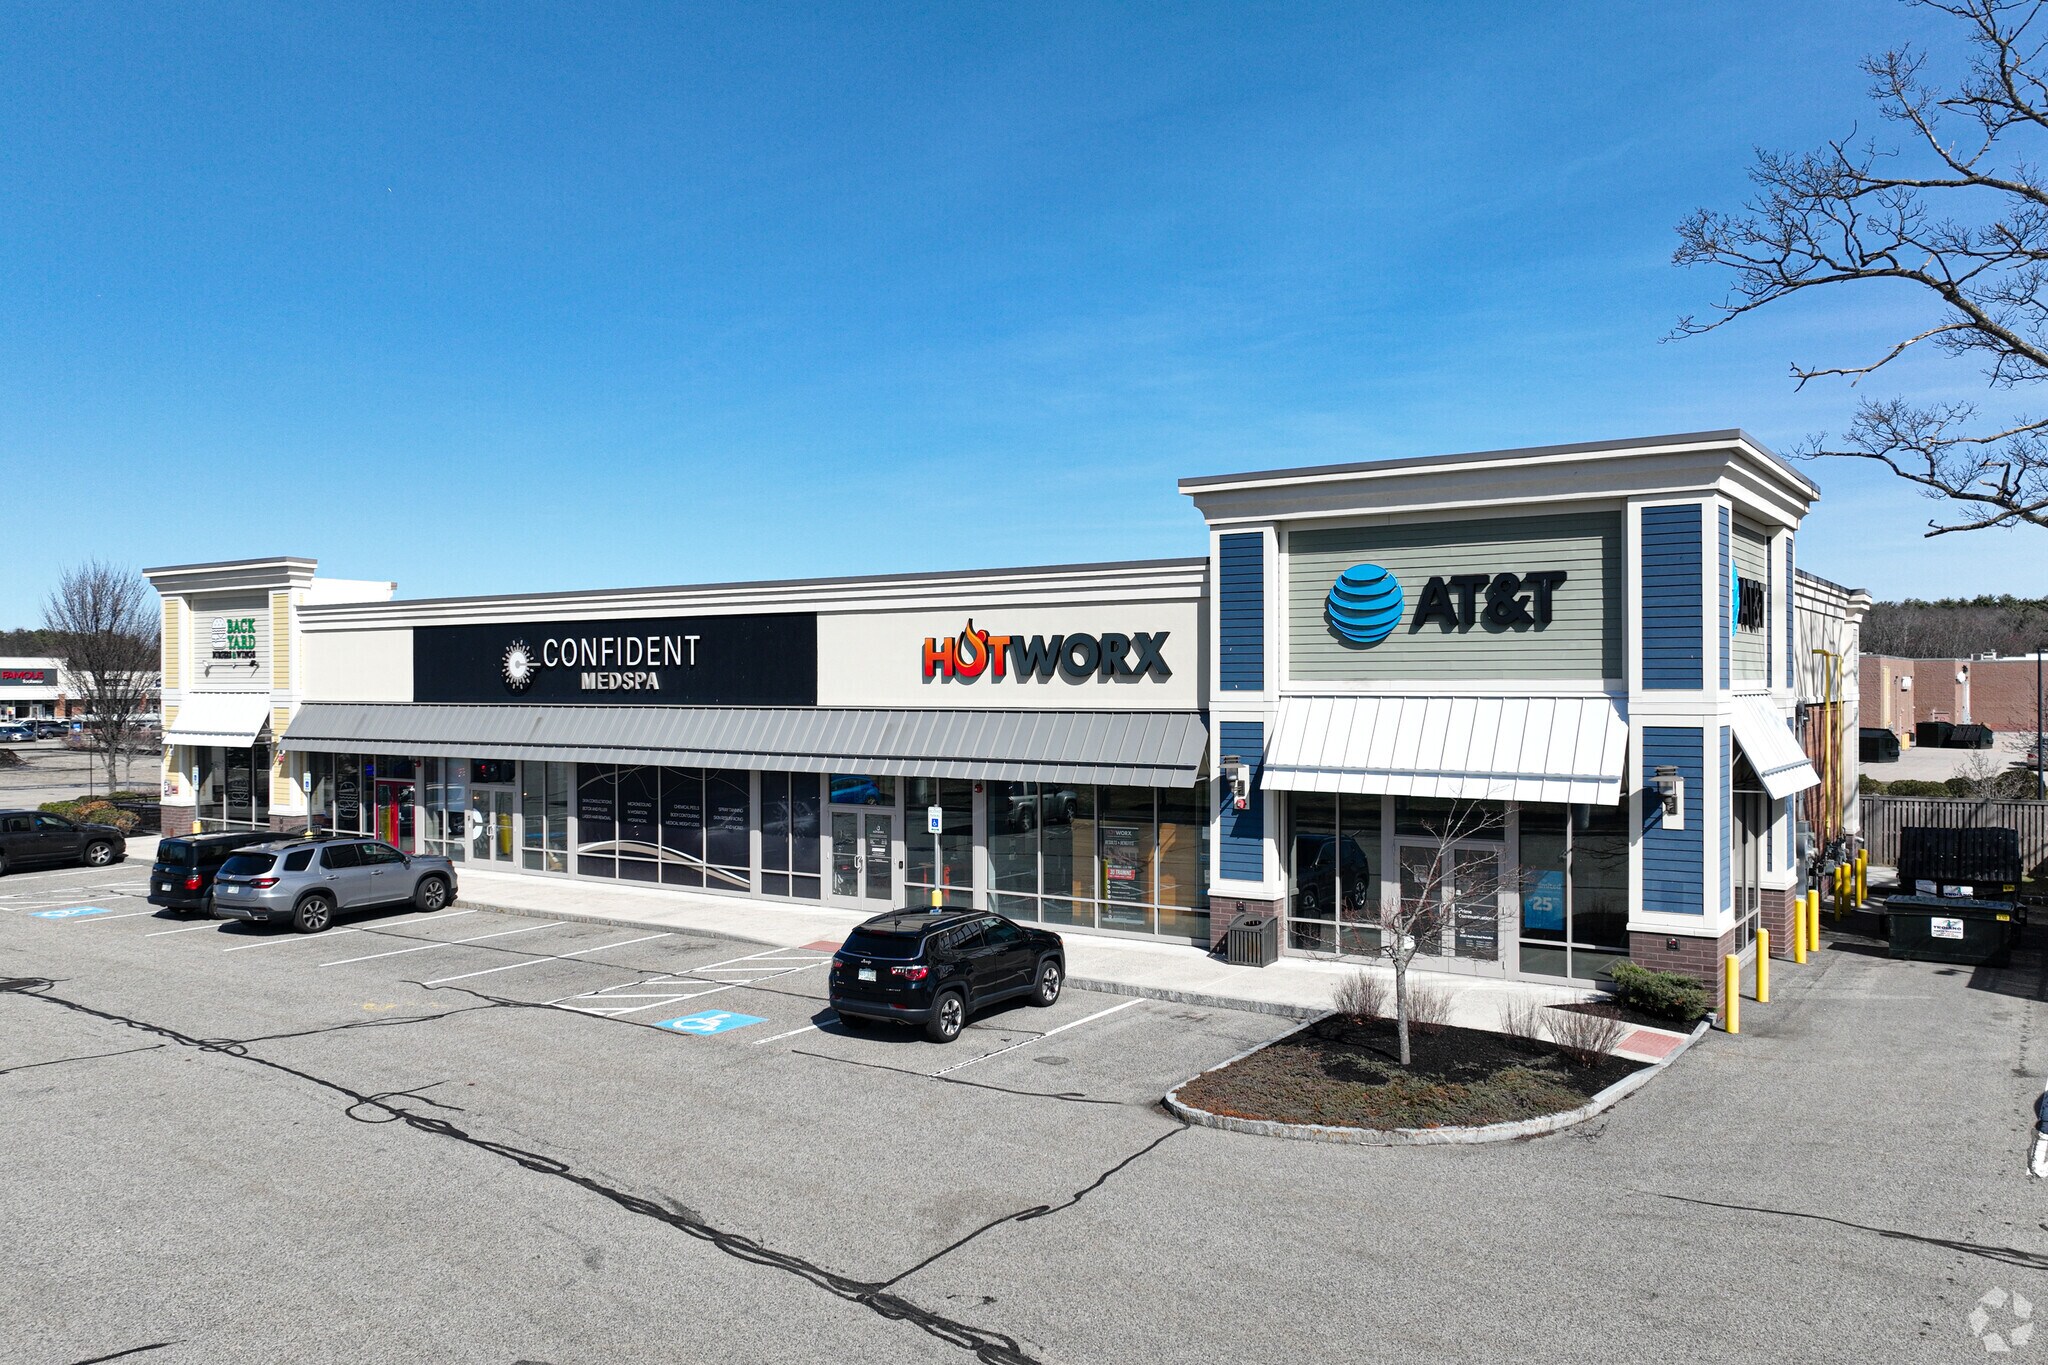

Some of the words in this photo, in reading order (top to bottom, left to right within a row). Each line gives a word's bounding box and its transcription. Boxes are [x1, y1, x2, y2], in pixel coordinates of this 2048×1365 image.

[1413, 571, 1567, 626] AT&T
[227, 618, 256, 634] BACK
[227, 635, 256, 650] YARD
[543, 635, 700, 667] CONFIDENT
[924, 618, 1173, 677] HOTWORX
[2, 671, 44, 680] FAMOUS
[581, 671, 660, 690] MEDSPA
